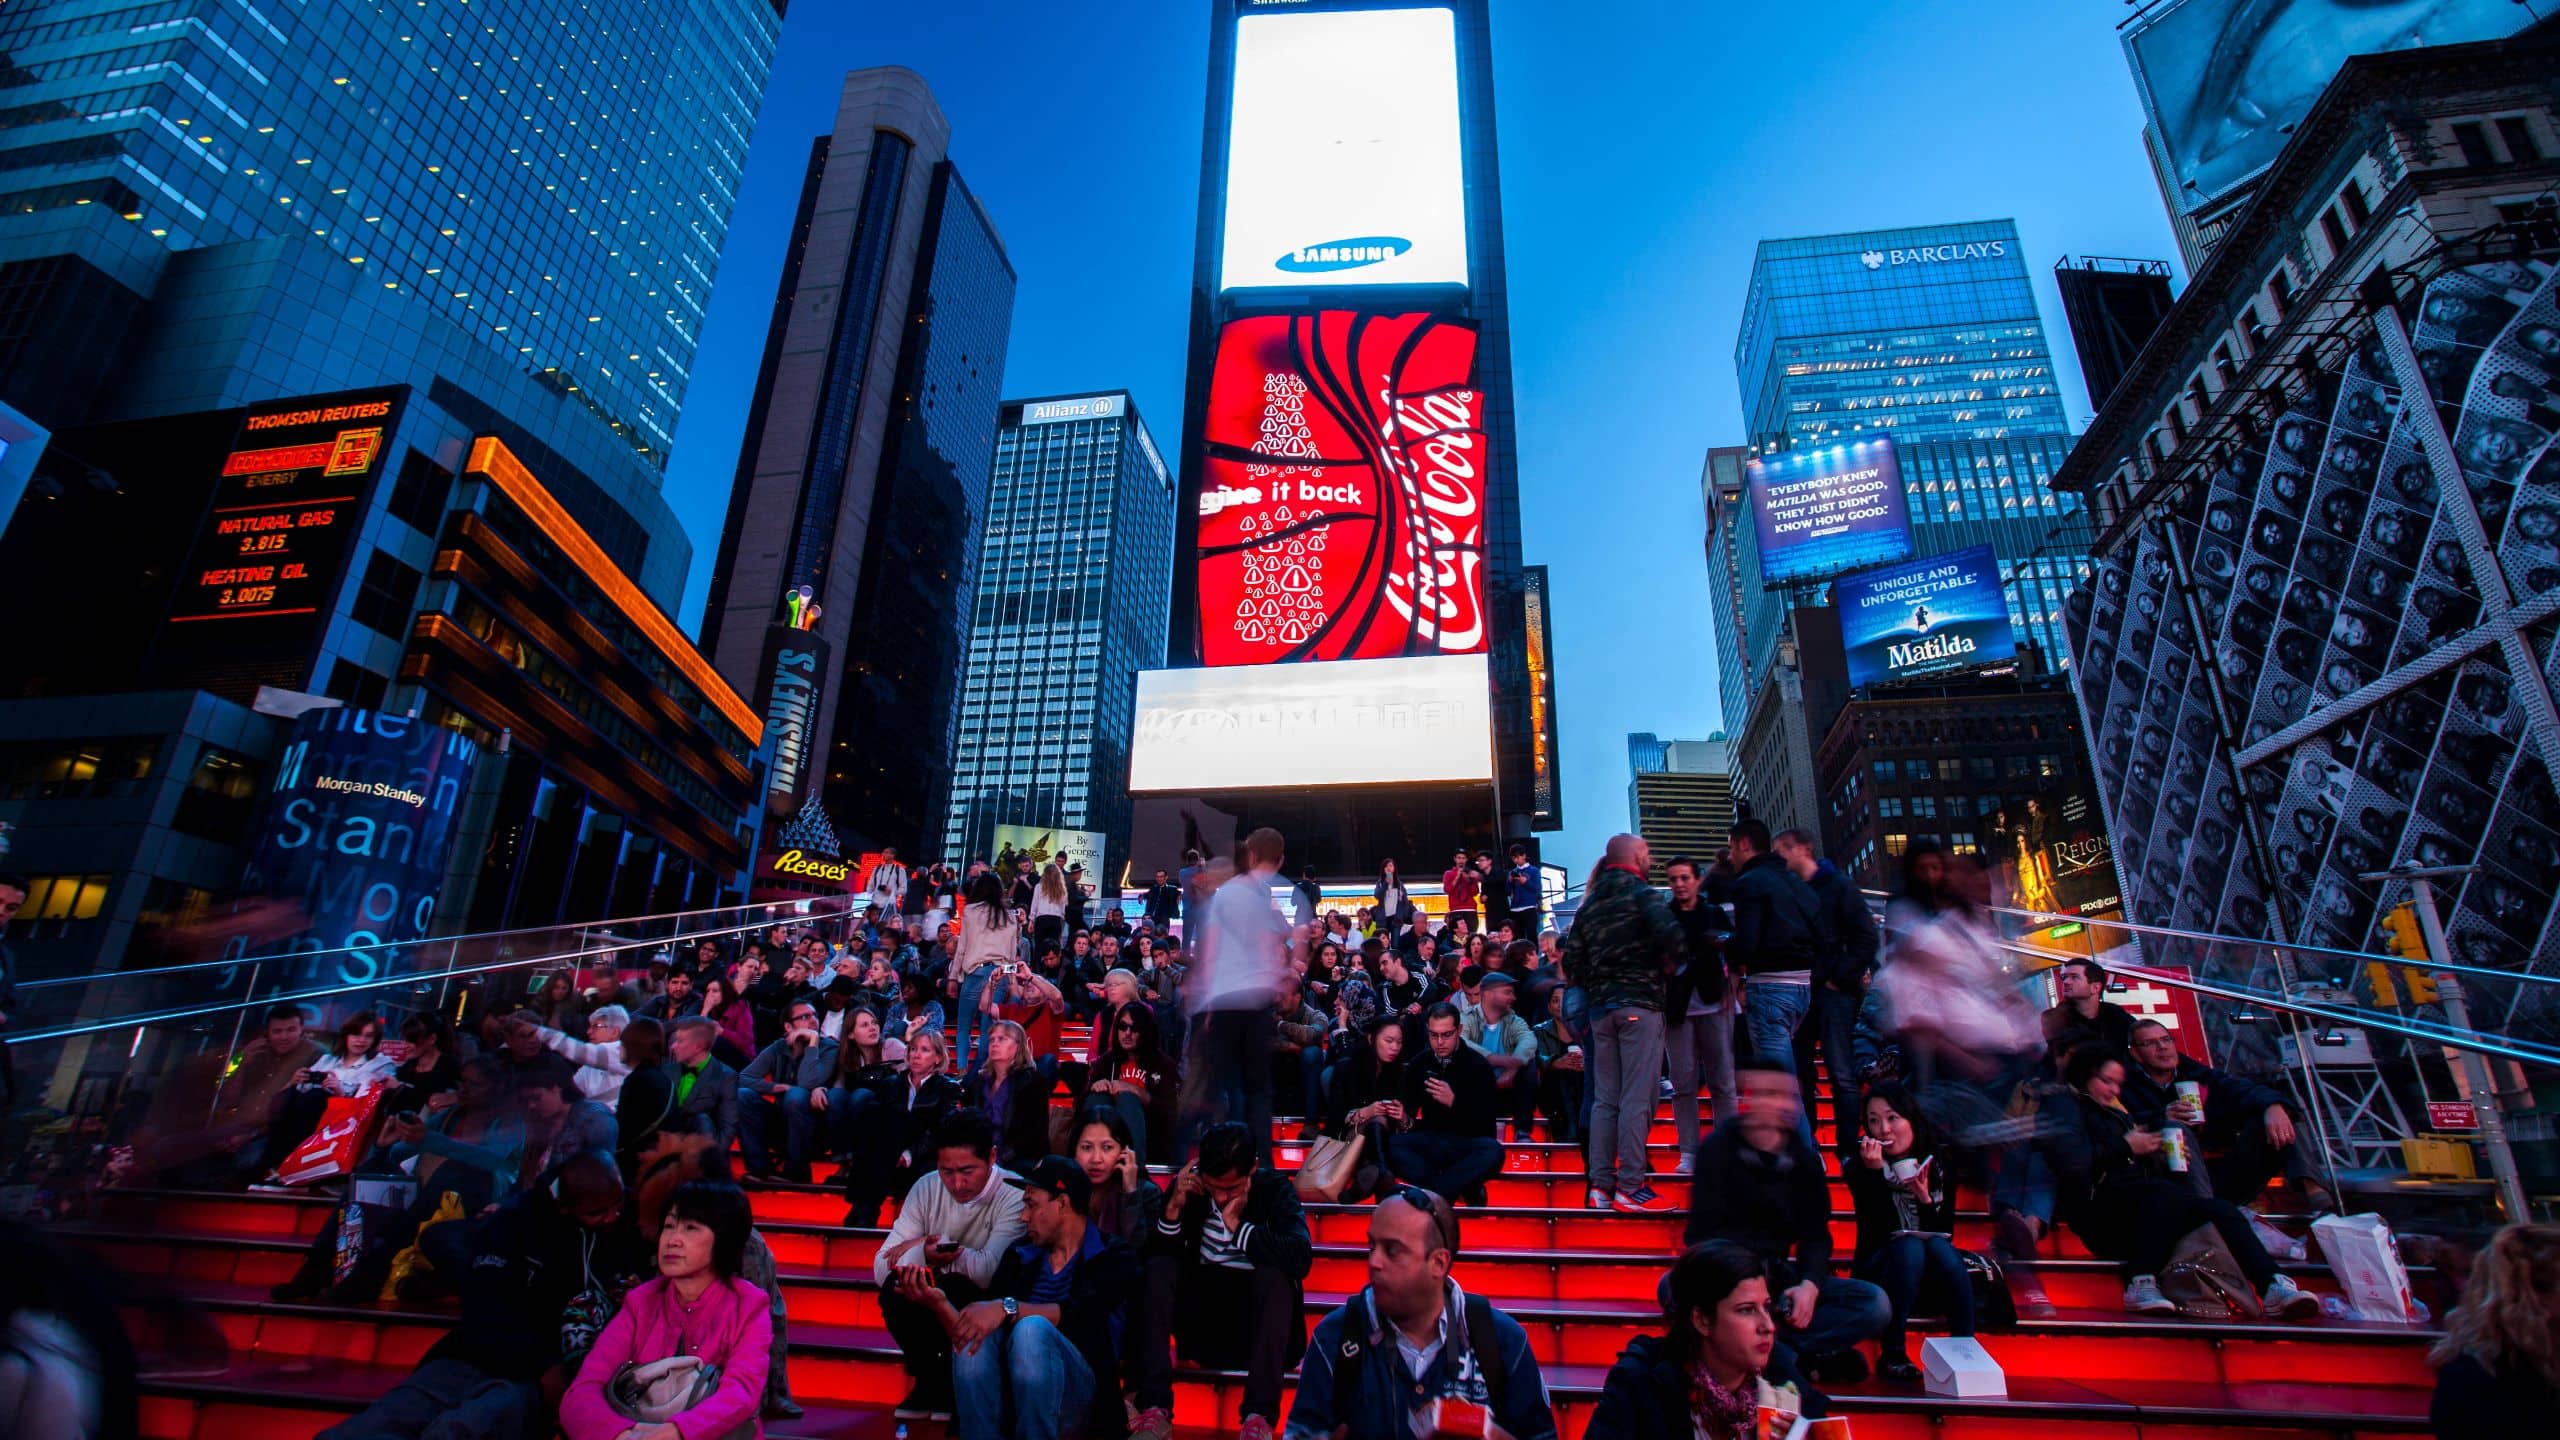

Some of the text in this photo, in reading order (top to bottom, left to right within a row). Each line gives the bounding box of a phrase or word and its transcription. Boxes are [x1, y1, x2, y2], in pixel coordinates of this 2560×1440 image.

[1293, 246, 1395, 263] SAMSUNG
[1890, 241, 2005, 266] BARCLAYS
[247, 401, 391, 430] THOMSON REUTERS
[1034, 402, 1089, 419] Allianz
[246, 471, 299, 487] ENERGY
[1842, 468, 1879, 483] KNEW
[1271, 481, 1291, 502] it
[1299, 480, 1362, 505] back
[1766, 481, 1888, 510] MATILDA WAS GOOD,
[1774, 494, 1880, 520] THEY JUST DIDN'T
[218, 510, 335, 534] NATURAL GAS
[1774, 519, 1813, 533] KNOW
[1815, 513, 1845, 526] HOW
[240, 534, 287, 552] 3.815
[200, 563, 308, 586] HEATING OIL
[1928, 565, 1958, 580] AND
[220, 586, 276, 604] 3.0075
[1887, 633, 1976, 669] Matilda
[766, 648, 816, 794] HERSHEY'S
[800, 687, 819, 769] MILK CHOCOLATE
[316, 775, 426, 808] Morgan Stanley
[1063, 844, 1100, 858] George,
[1076, 835, 1089, 847] By
[2053, 834, 2110, 868] REIGN
[774, 849, 849, 881] Reese's
